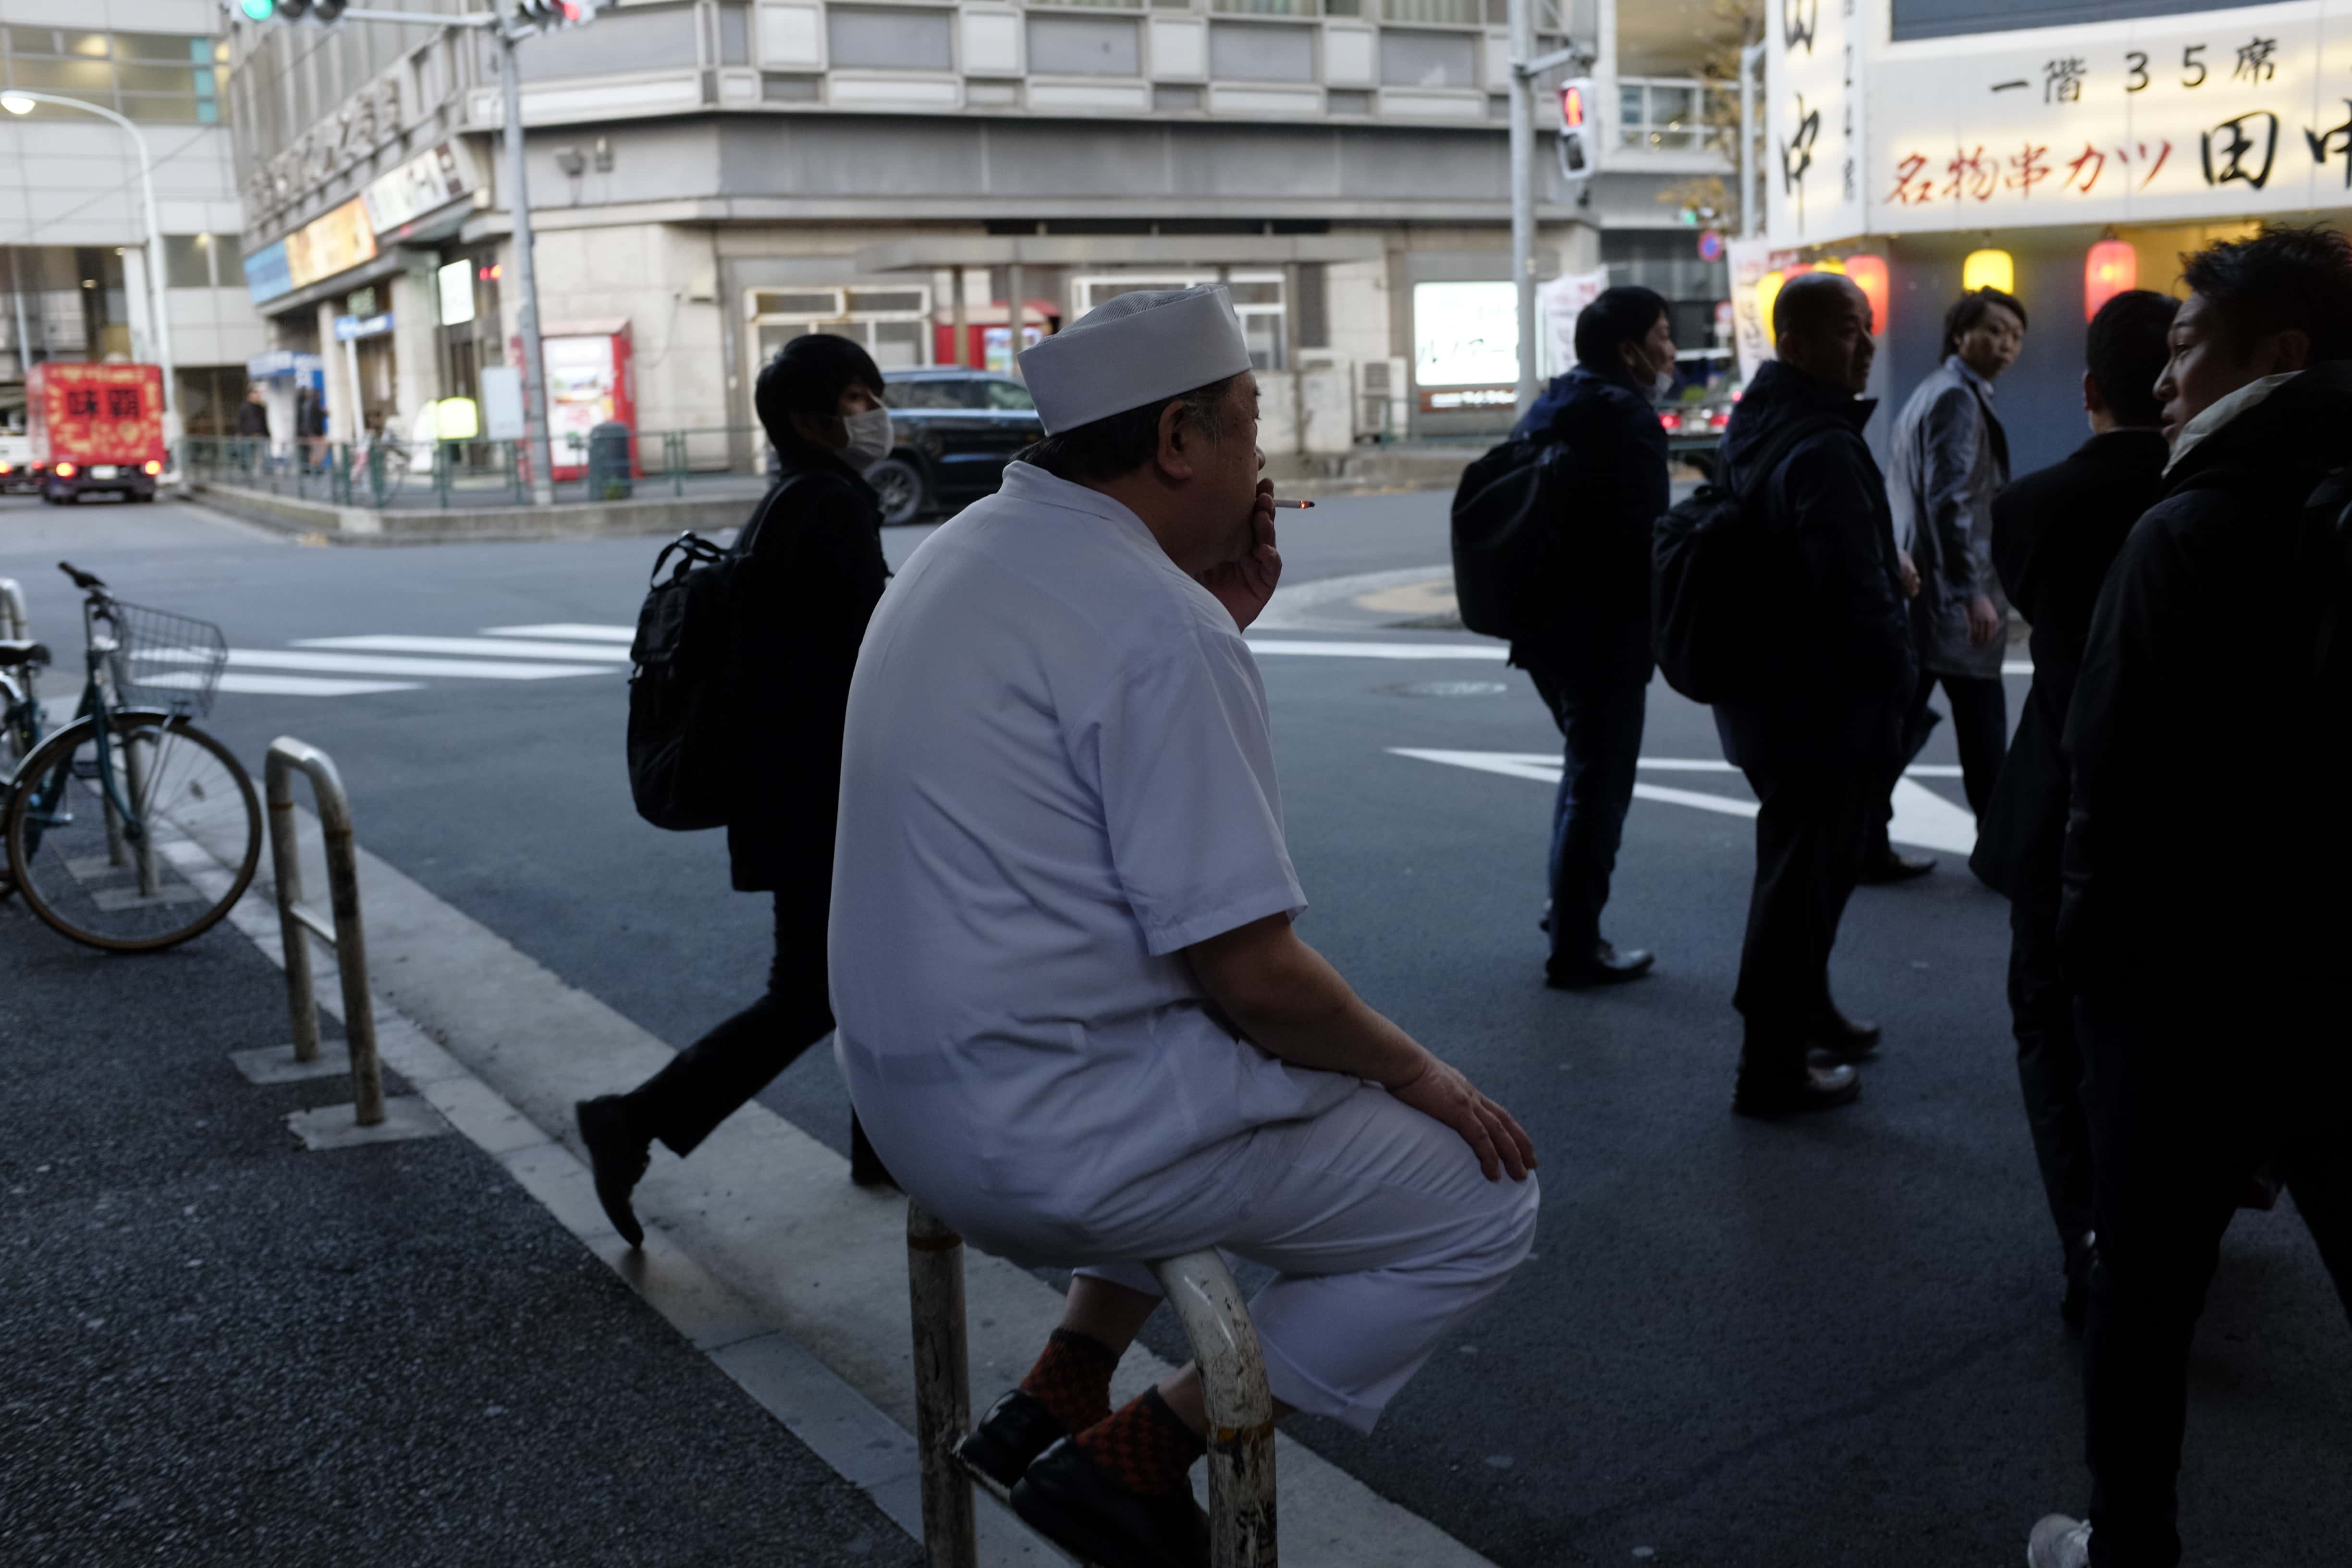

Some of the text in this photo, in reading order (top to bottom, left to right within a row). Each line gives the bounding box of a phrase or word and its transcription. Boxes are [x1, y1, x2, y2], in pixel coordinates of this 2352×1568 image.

[1884, 136, 2172, 205] 名物串カツ
